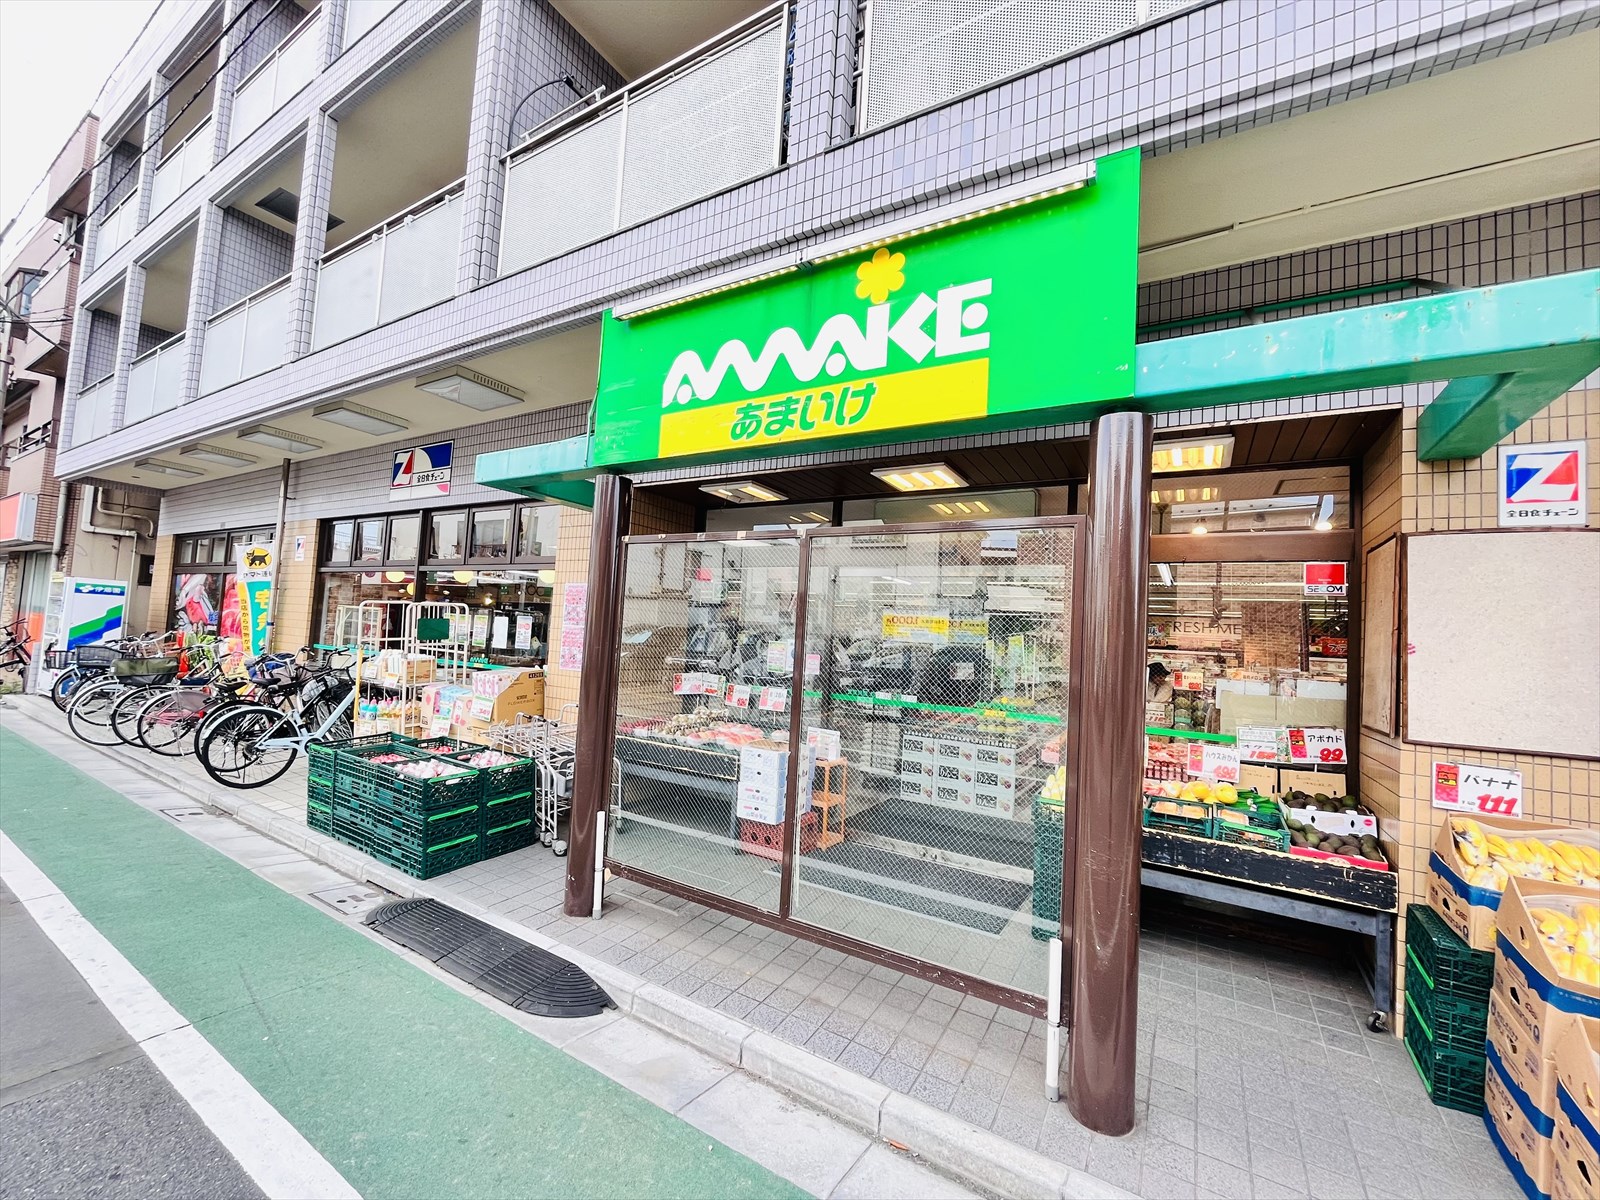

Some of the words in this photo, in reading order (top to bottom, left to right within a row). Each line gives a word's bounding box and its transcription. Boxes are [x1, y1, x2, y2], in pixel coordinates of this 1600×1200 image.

[662, 278, 993, 410] AMAIKE
[730, 382, 877, 441] あまいけ
[416, 471, 445, 484] 全日食チェーン
[1506, 507, 1579, 518] 全日食チェーン
[1307, 585, 1343, 593] SECOM
[1205, 750, 1238, 763] ハウスみかん
[1320, 747, 1344, 762] 99
[1464, 774, 1518, 790] バナナ
[1477, 794, 1518, 815] 111
